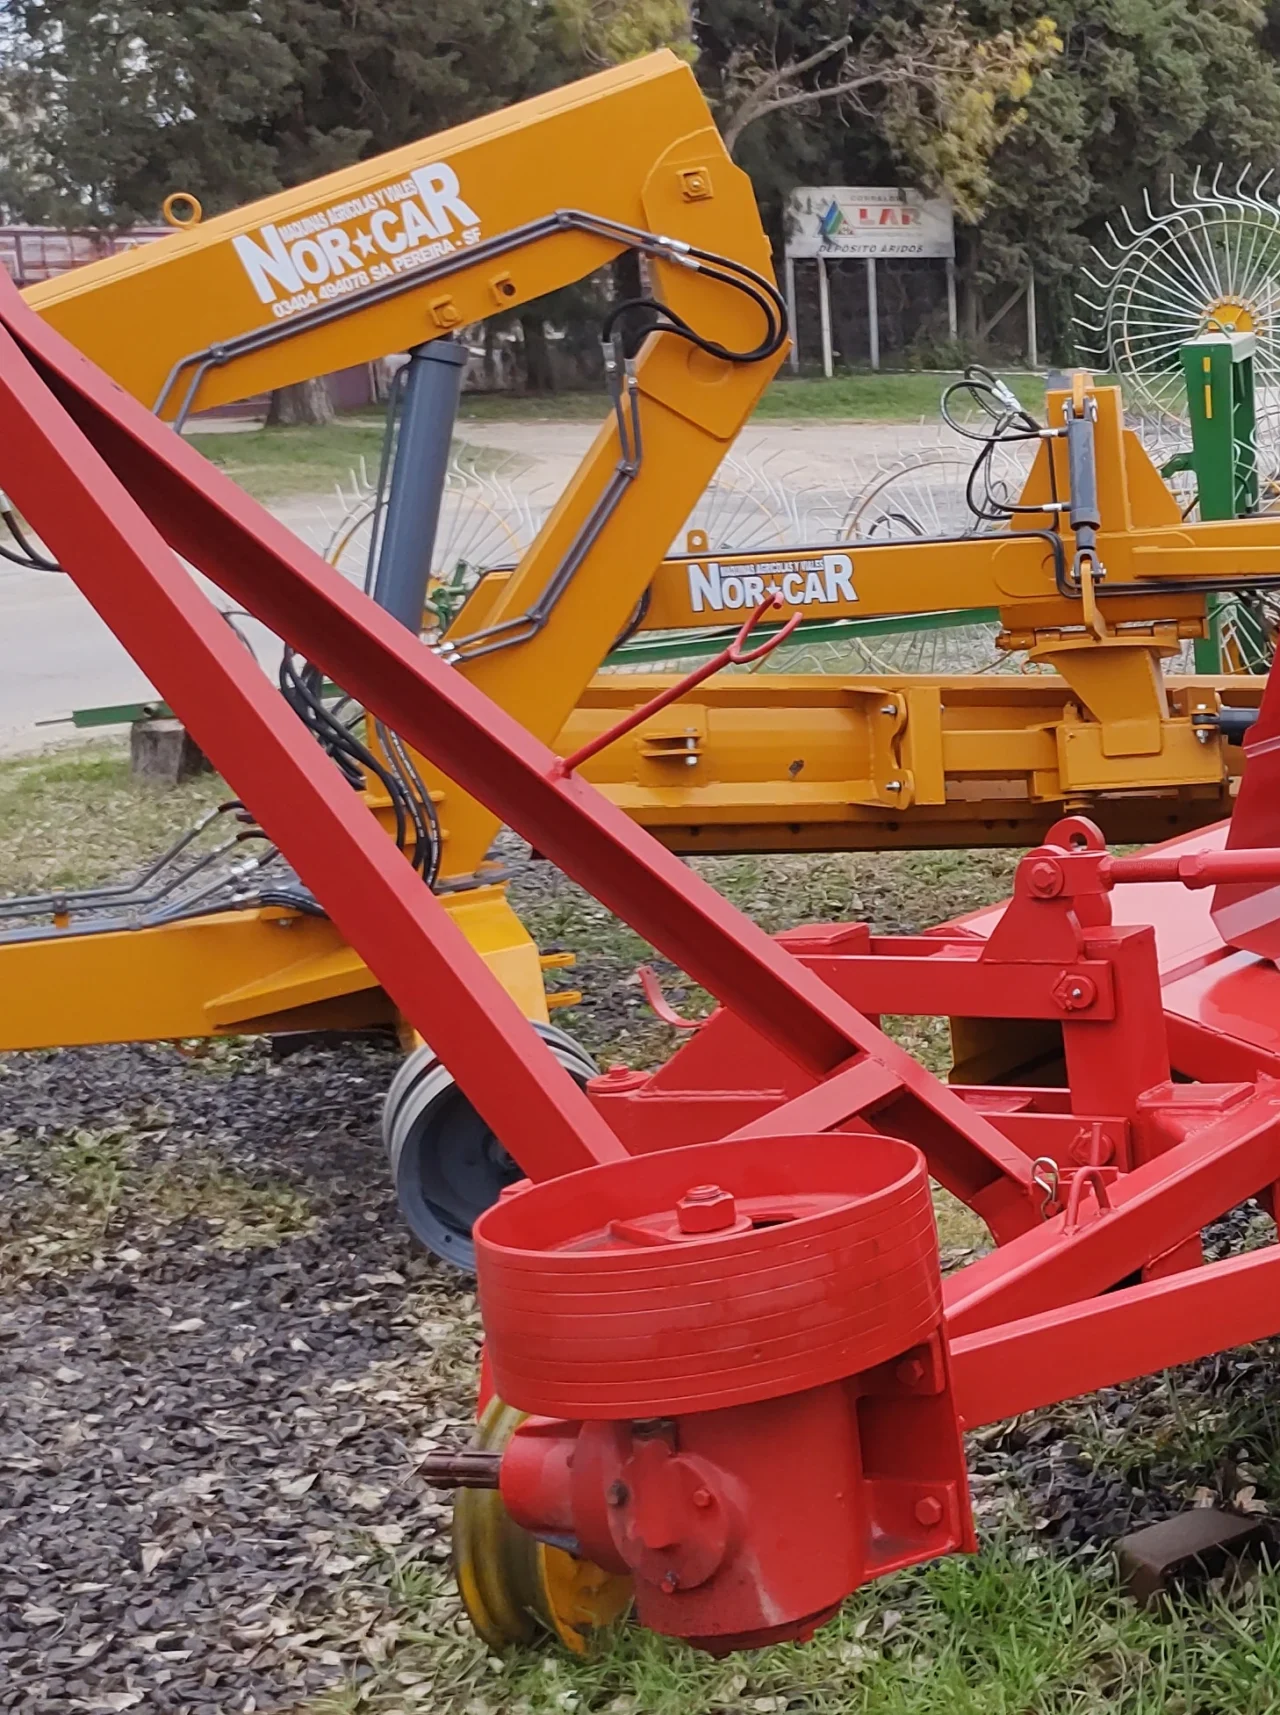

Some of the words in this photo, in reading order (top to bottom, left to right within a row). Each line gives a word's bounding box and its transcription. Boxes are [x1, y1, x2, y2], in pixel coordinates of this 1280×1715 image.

[859, 208, 922, 226] LAR
[272, 289, 319, 318] 03404
[319, 272, 371, 300] 494078
[369, 261, 394, 281] SA
[392, 239, 457, 273] PEREIRA
[460, 227, 482, 247] SF
